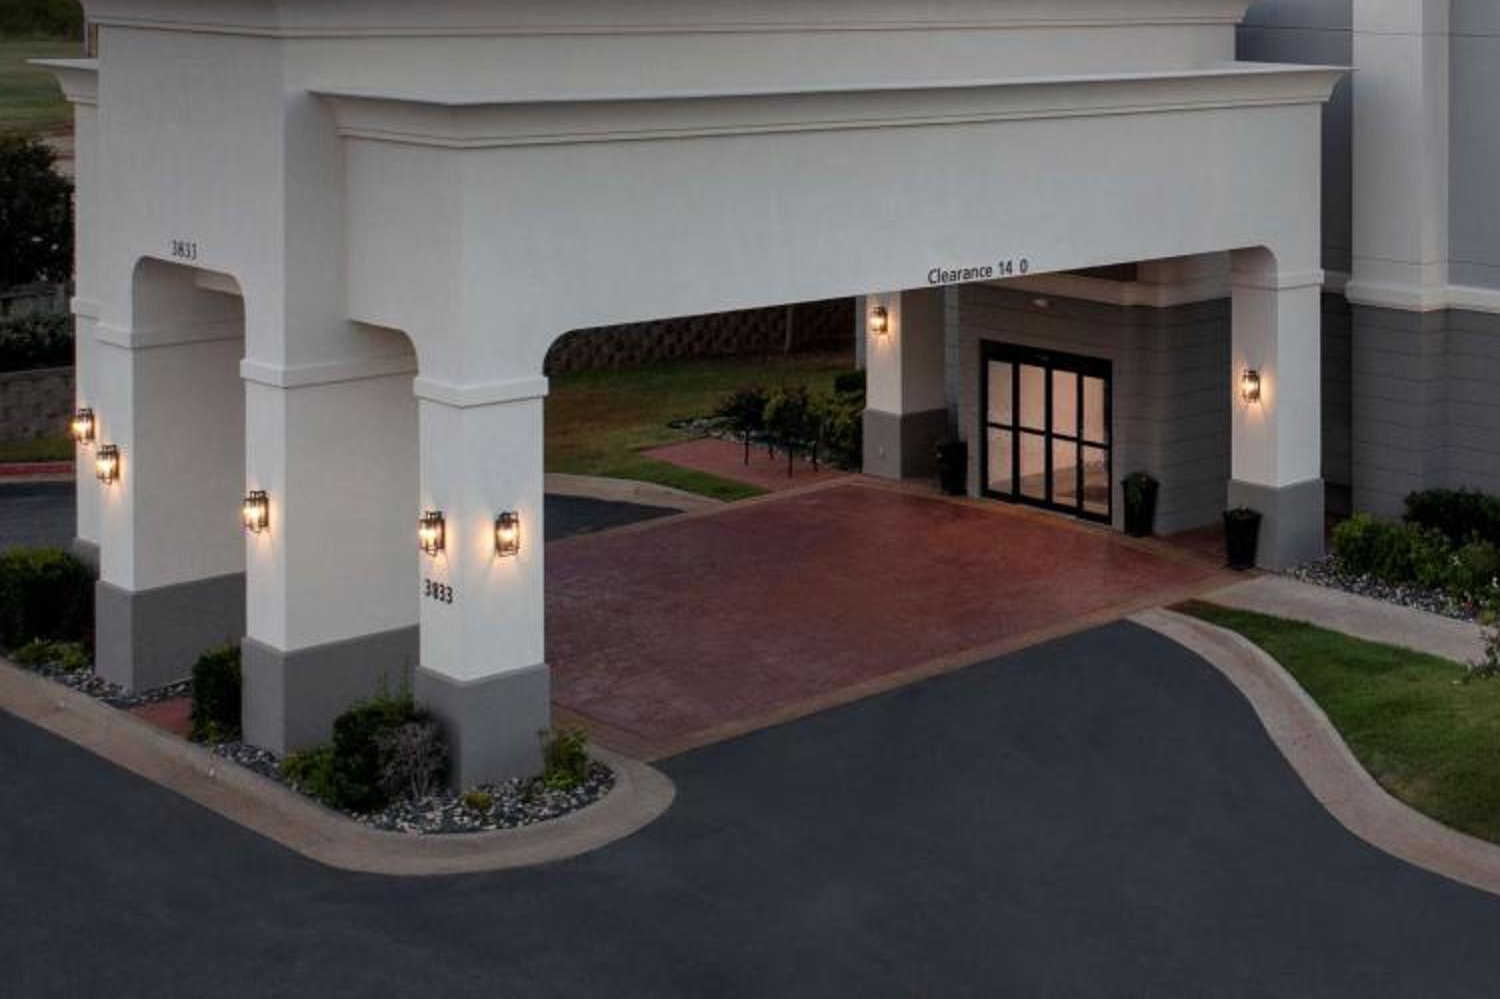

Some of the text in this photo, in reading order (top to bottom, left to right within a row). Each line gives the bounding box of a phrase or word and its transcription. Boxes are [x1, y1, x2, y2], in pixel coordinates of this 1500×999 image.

[171, 238, 198, 260] 3833
[927, 258, 1029, 284] Clearance 14 0
